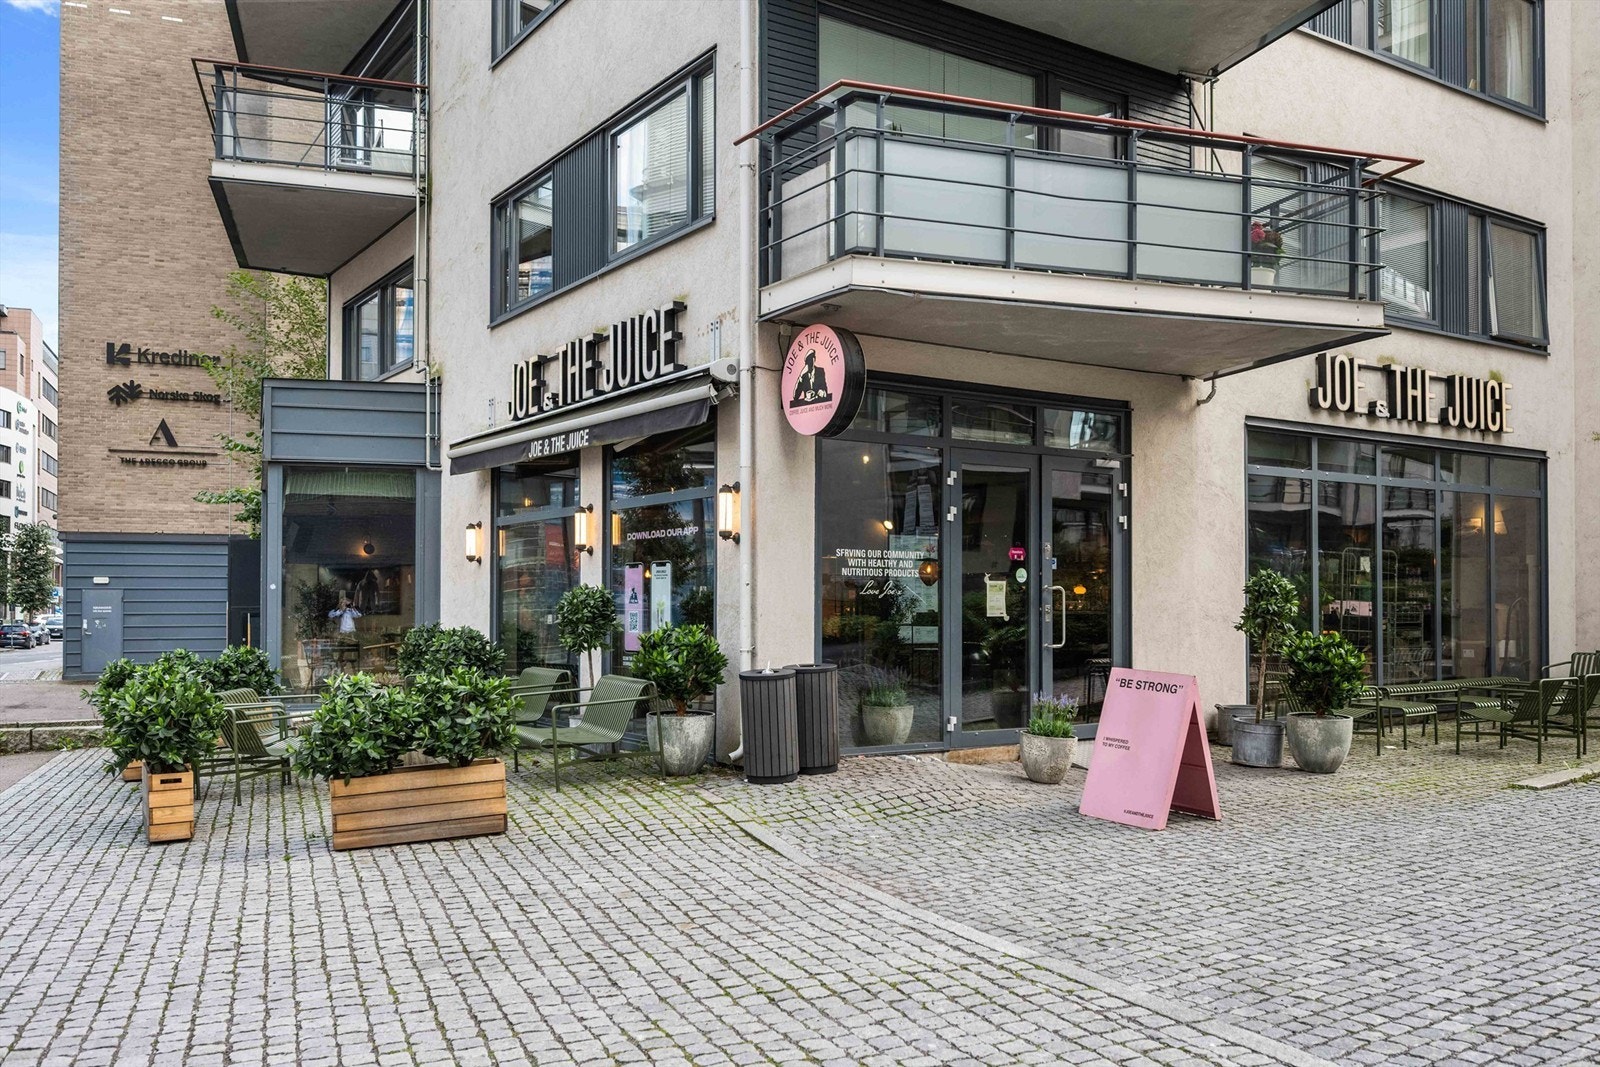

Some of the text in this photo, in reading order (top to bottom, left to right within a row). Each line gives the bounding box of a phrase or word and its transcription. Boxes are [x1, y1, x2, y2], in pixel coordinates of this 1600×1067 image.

[507, 301, 677, 420] JOE & THE JUICE
[786, 331, 840, 375] JOE & THE JUICE
[149, 389, 221, 405] Norske Skog
[1316, 352, 1515, 433] JOE & THE JUICE
[528, 429, 590, 458] JOE & THE JUICE
[120, 457, 137, 465] THE
[177, 459, 207, 467] GROUP
[627, 526, 699, 541] DOWNLOAD OUR APP
[867, 549, 882, 559] OUR
[883, 550, 925, 559] COMMUNITY
[848, 558, 914, 568] WITH HEALTHY AND
[841, 567, 919, 577] NUTRITIOUS PRODUCTS
[860, 580, 880, 595] Love
[1105, 736, 1129, 745] WHISPERED
[1114, 743, 1131, 751] COFFEE
